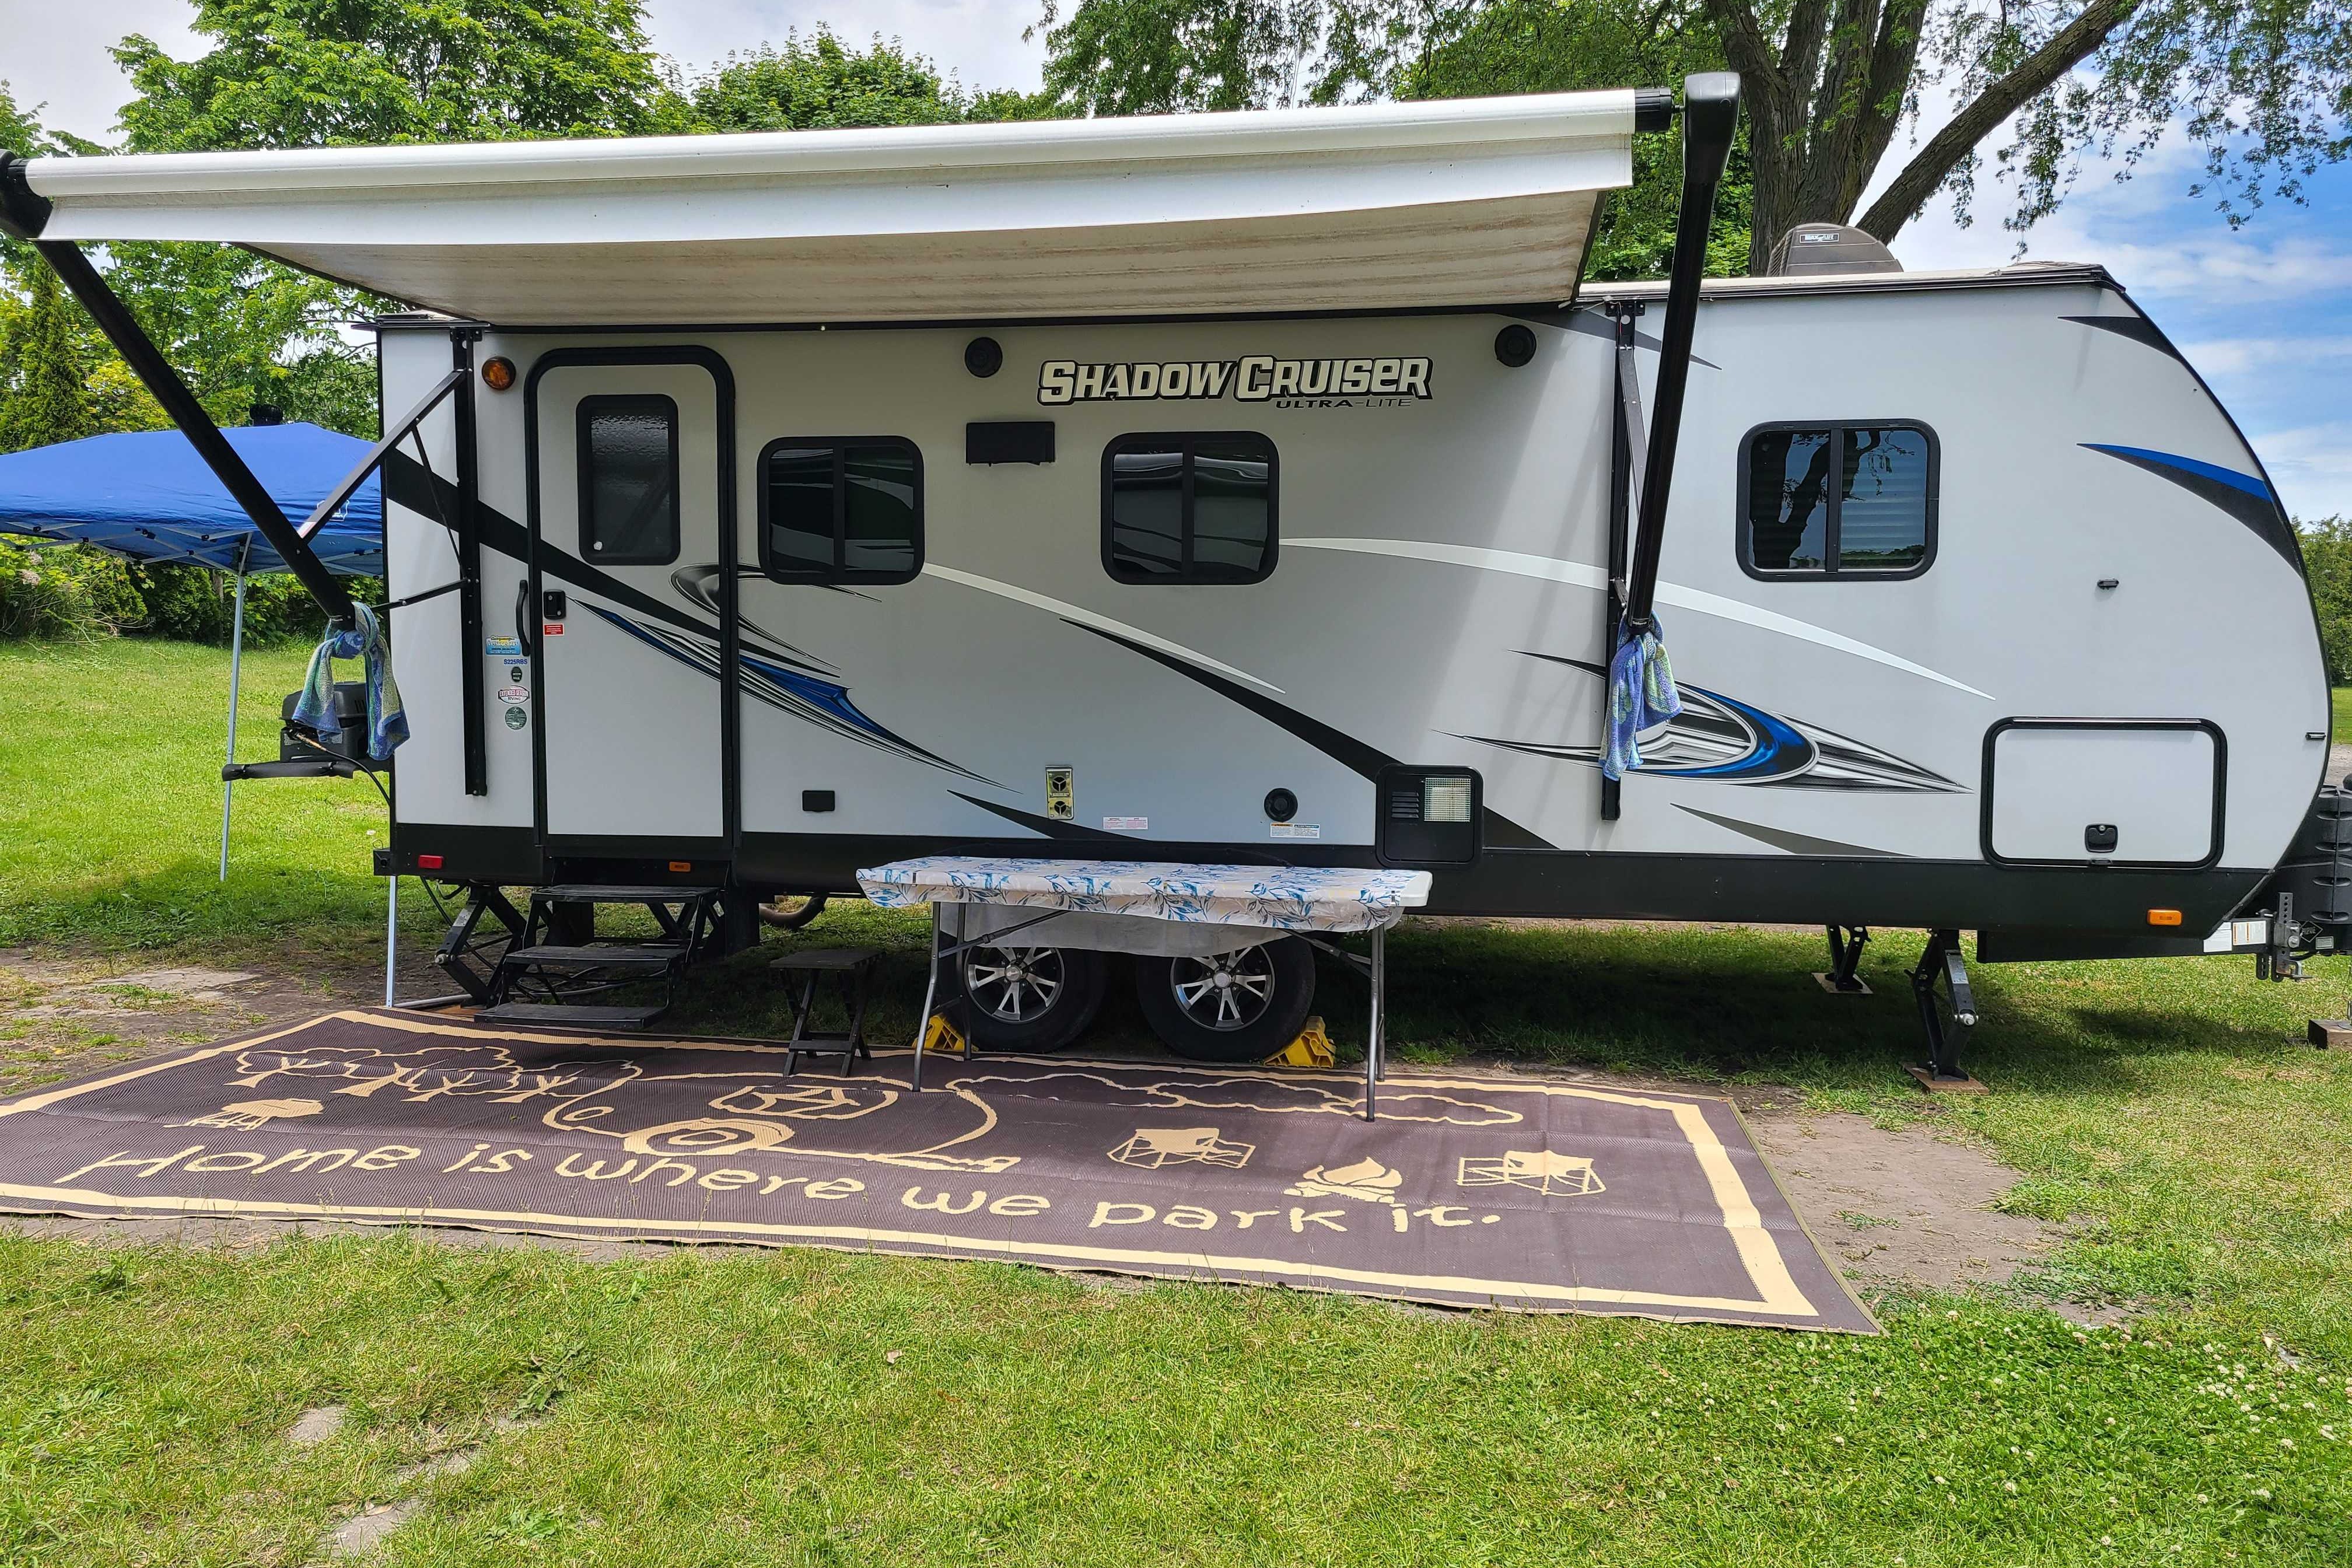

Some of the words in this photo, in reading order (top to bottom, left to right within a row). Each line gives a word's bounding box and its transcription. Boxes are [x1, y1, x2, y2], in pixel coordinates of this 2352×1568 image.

[1037, 359, 1236, 407] SHADOW
[1276, 399, 1412, 409] ULTRA-LITE
[52, 1143, 421, 1184] Home
[442, 1143, 533, 1174] is
[554, 1153, 864, 1200] where
[901, 1185, 1051, 1217] we
[1087, 1199, 1348, 1233] park
[1388, 1203, 1501, 1233] it.
